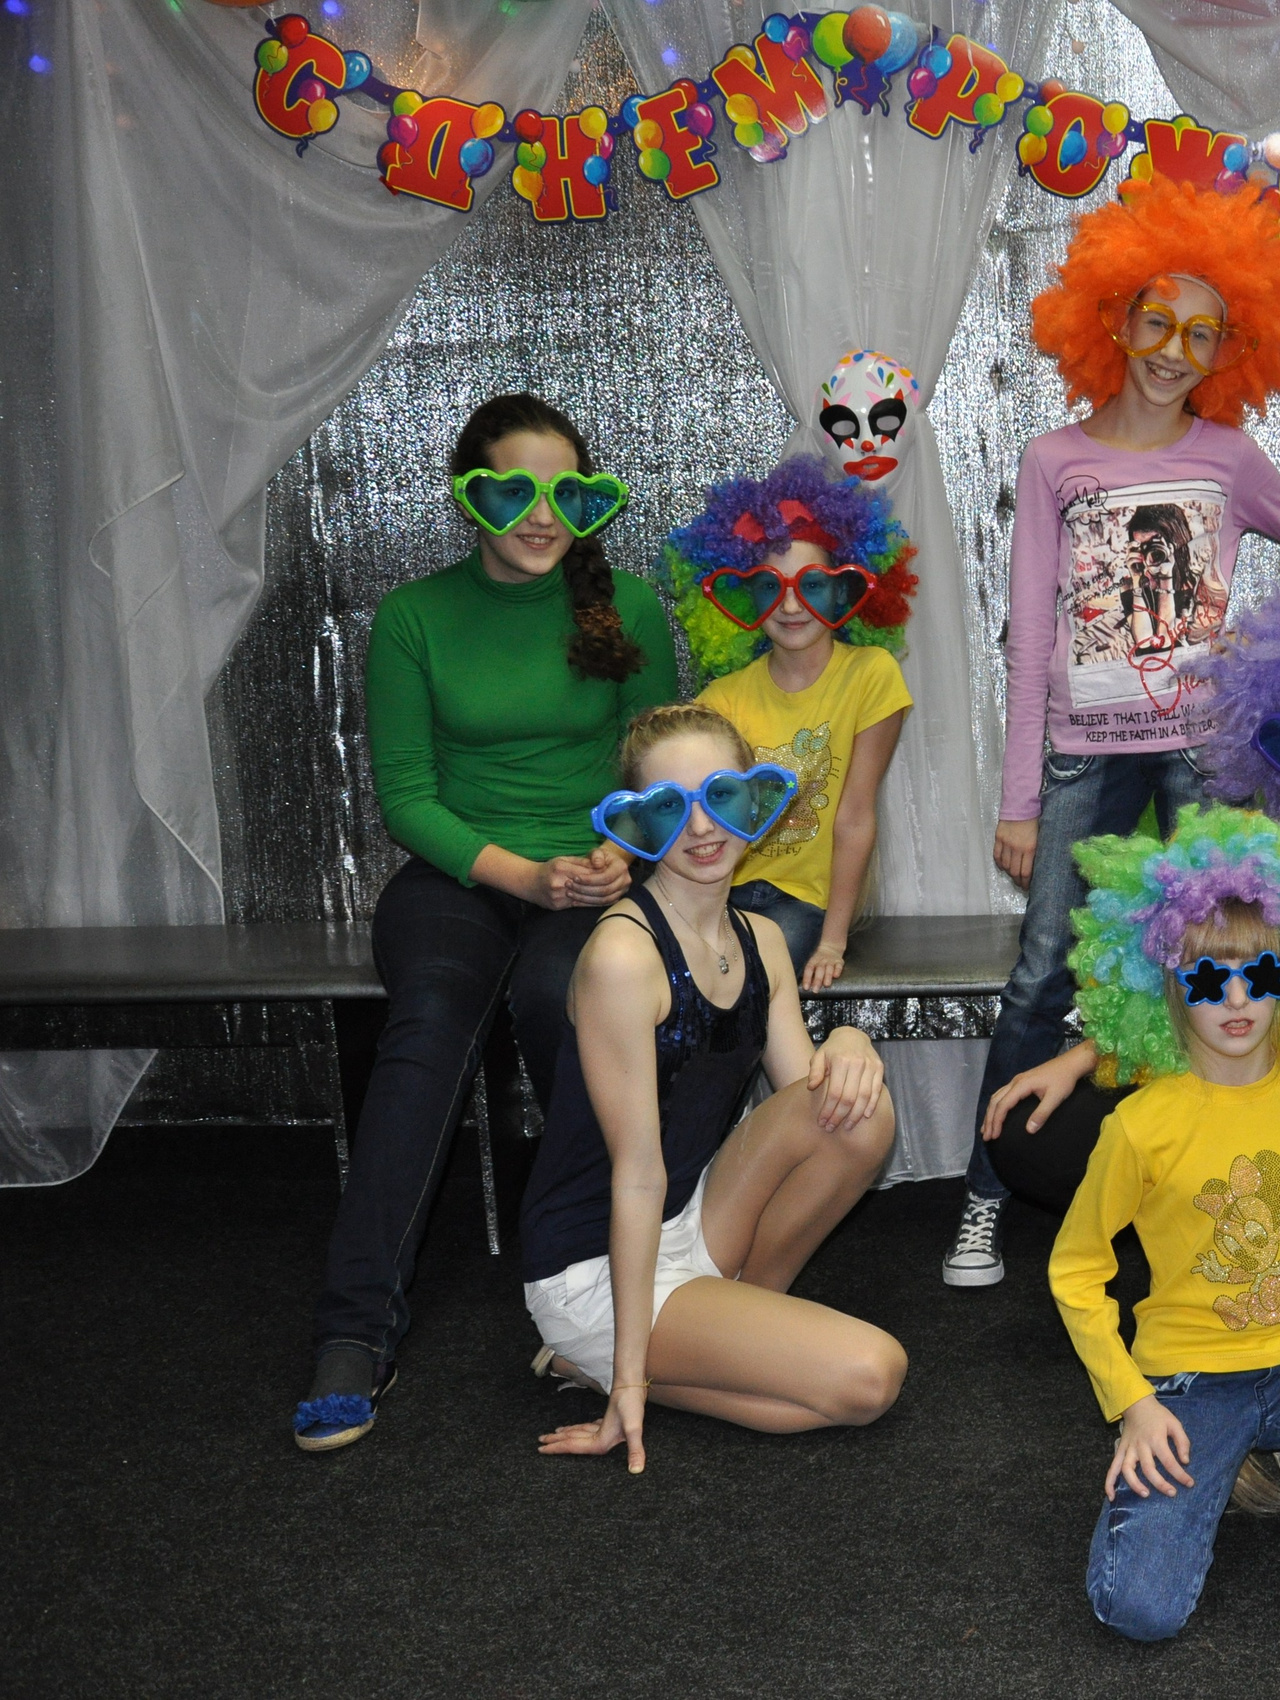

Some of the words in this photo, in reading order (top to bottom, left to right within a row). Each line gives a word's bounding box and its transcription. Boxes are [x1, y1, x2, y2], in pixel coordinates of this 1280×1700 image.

[256, 30, 347, 137] С
[386, 31, 827, 221] ДНЕМ
[1068, 713, 1110, 727] BELIEVE
[1113, 711, 1142, 725] THAT
[1144, 712, 1150, 724] I
[1150, 708, 1181, 723] STILL
[1085, 731, 1108, 743] KEEP
[1109, 730, 1128, 743] THE
[1129, 727, 1157, 741] FAITH
[1158, 727, 1170, 739] IN
[1171, 725, 1180, 737] A
